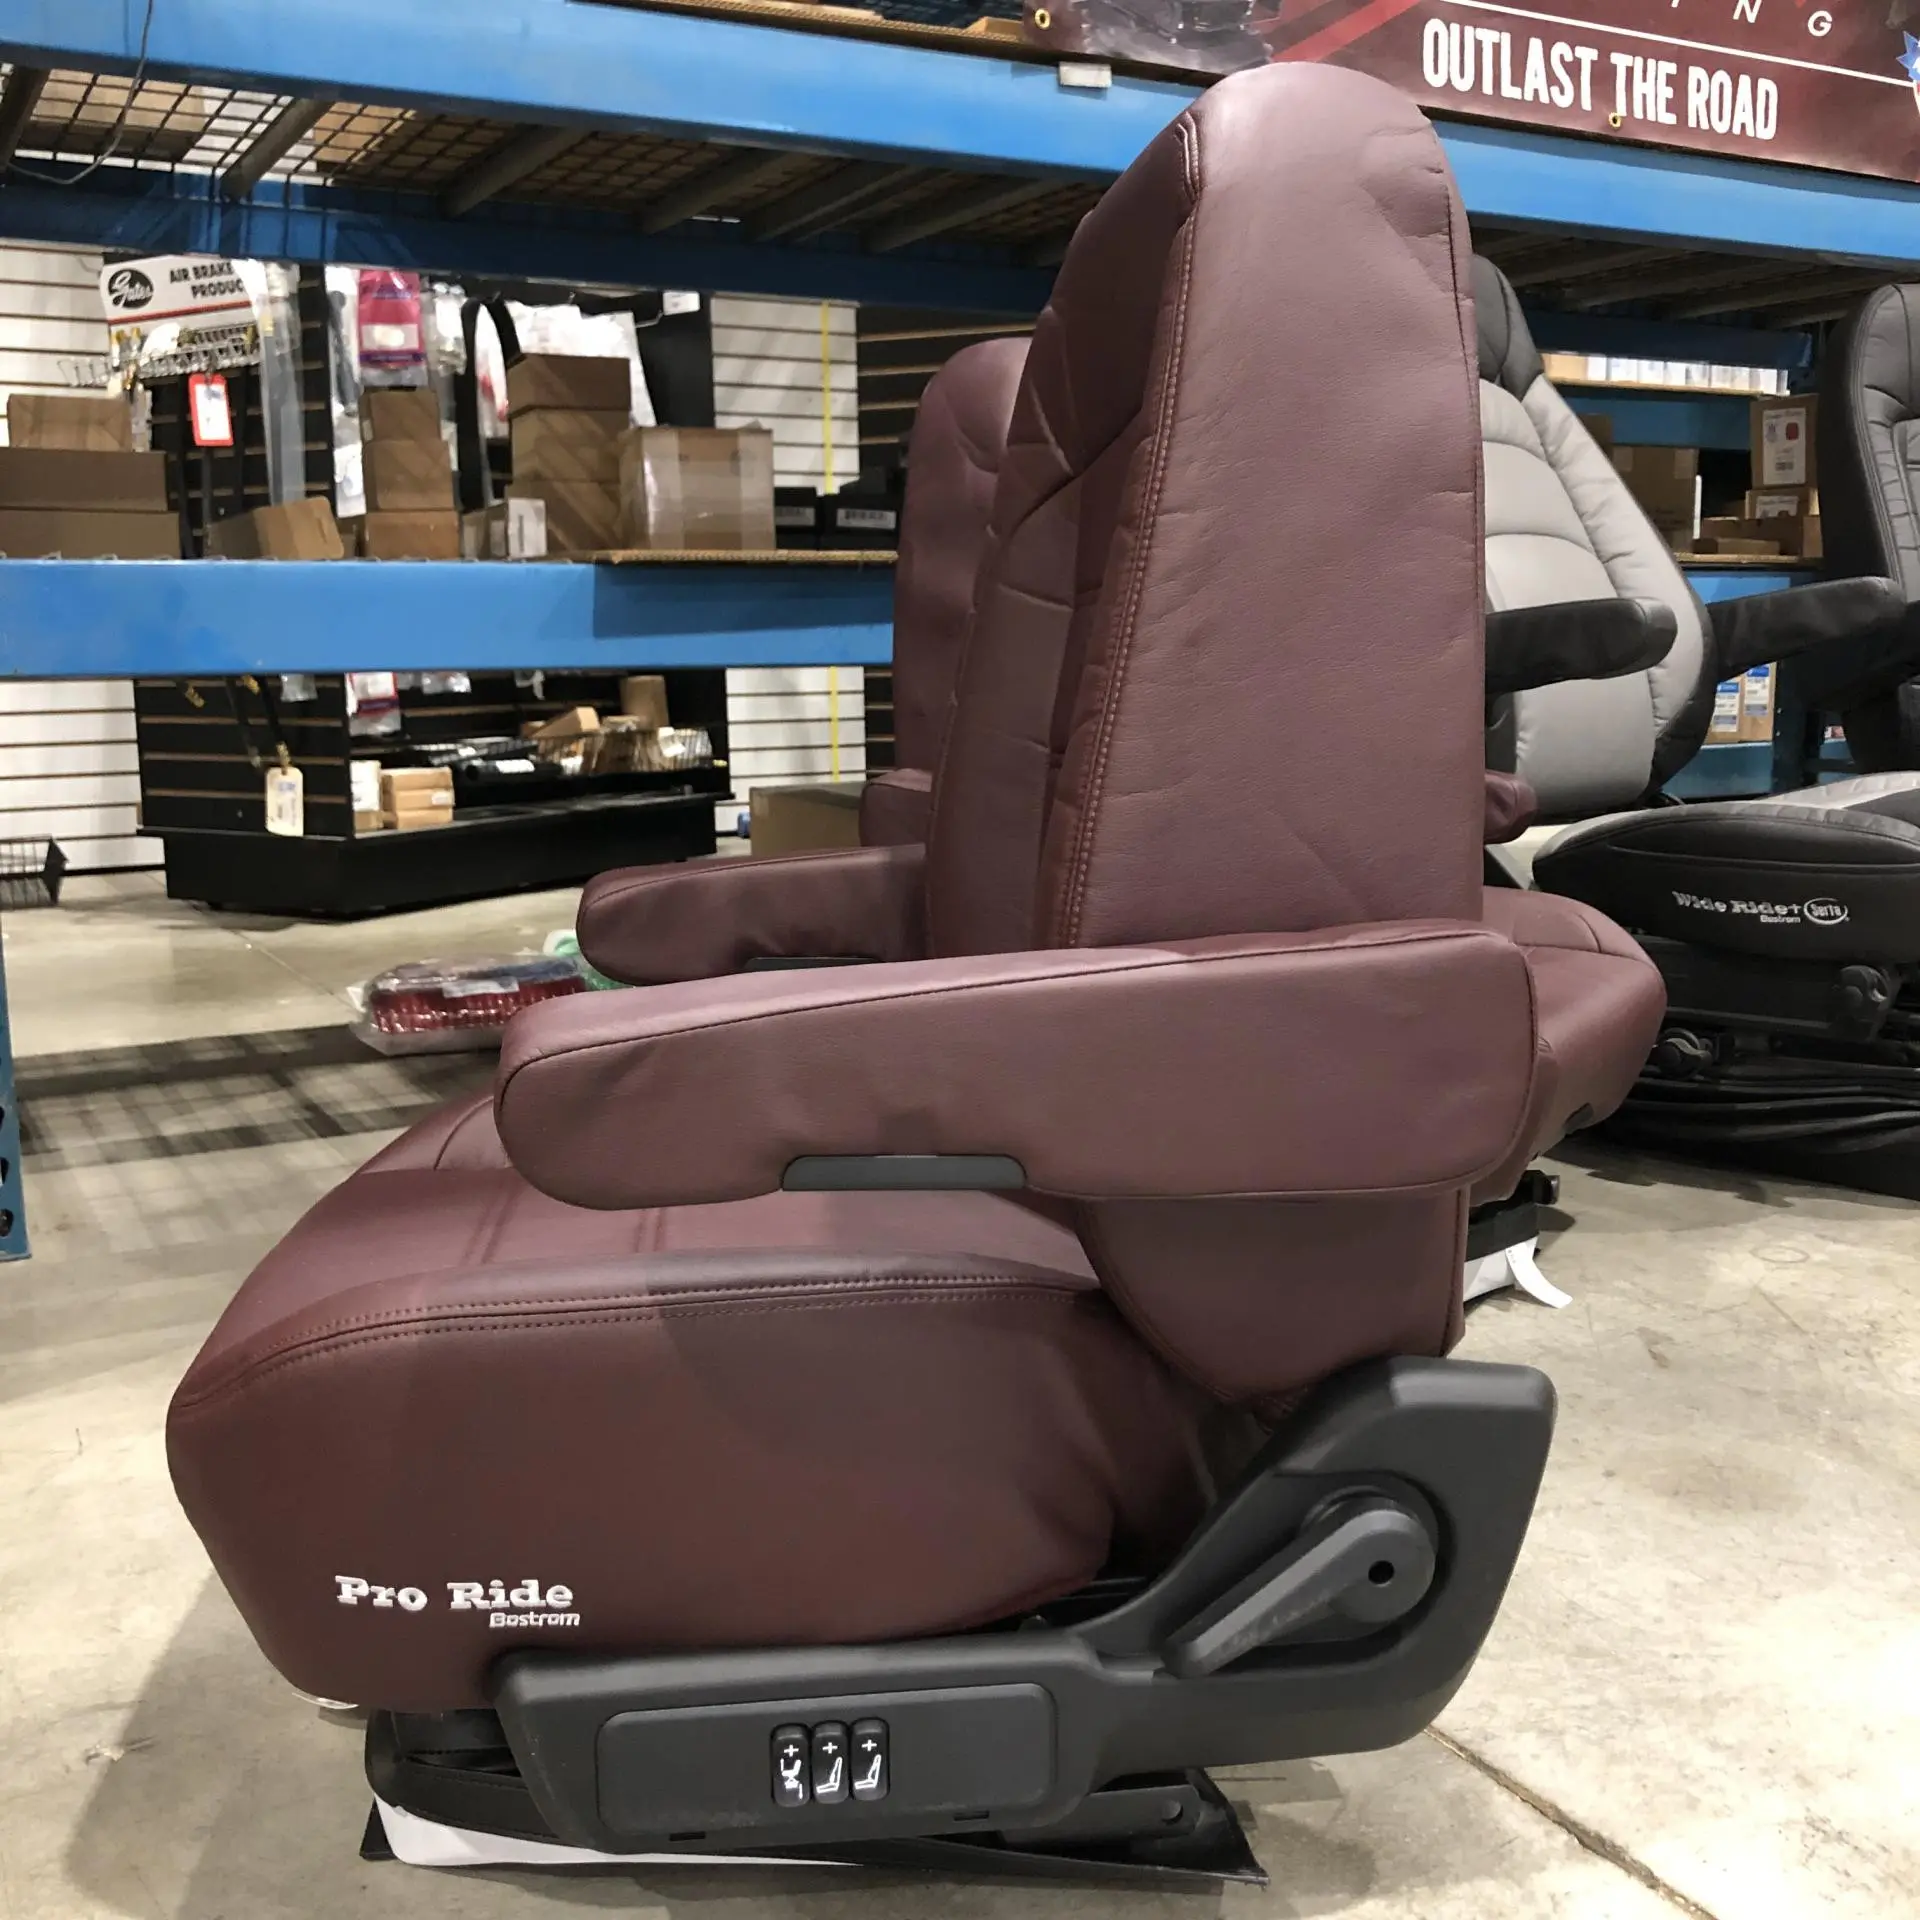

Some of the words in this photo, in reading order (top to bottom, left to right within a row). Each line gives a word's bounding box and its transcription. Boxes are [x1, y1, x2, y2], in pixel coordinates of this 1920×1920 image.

[1422, 18, 1599, 111] OUTLAST
[1610, 52, 1677, 125] THE
[1687, 66, 1779, 140] ROAD
[169, 266, 190, 284] AIR
[192, 262, 234, 280] BRAKE
[191, 278, 244, 299] PRODUC
[1672, 891, 1727, 912] Wide
[1760, 915, 1801, 923] Bostrom
[335, 1575, 428, 1611] Pro
[446, 1579, 574, 1610] Ride
[489, 1611, 581, 1628] Bostrom
